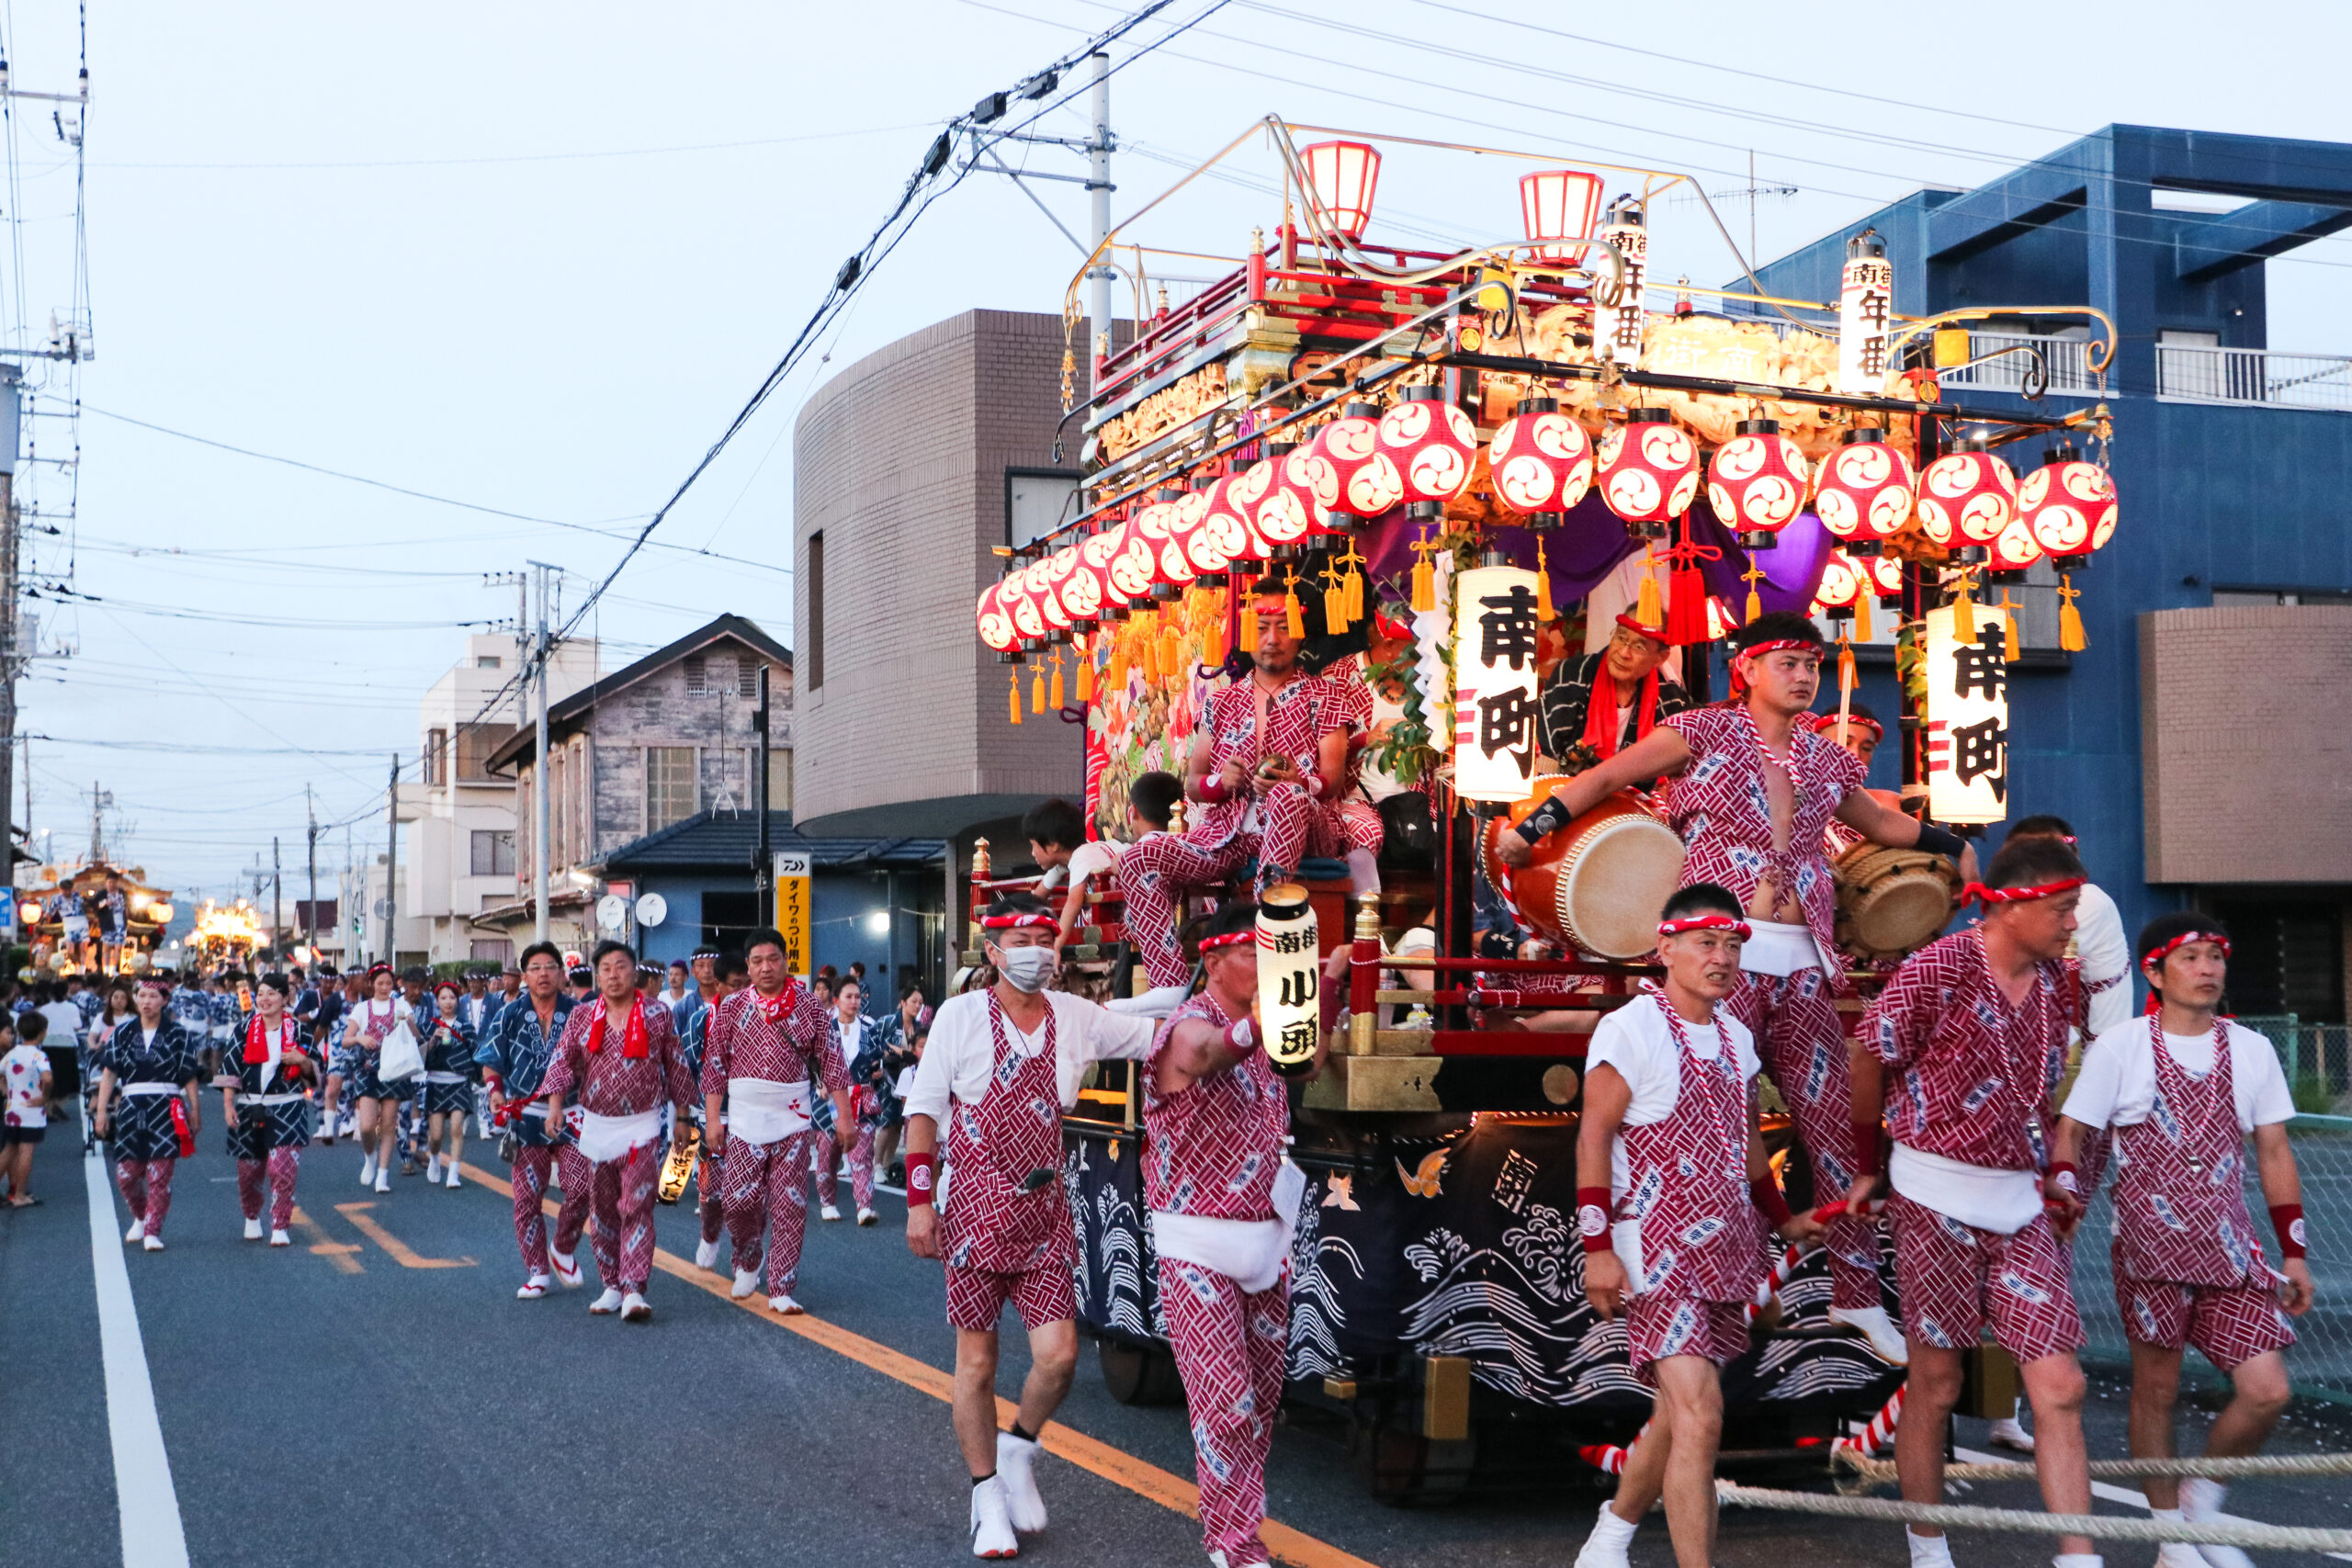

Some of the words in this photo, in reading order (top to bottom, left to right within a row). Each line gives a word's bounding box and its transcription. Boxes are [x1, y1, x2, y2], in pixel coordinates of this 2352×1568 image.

[1858, 289, 1888, 378] 年番
[1477, 585, 1539, 780] 南町
[1951, 622, 2008, 804] 南町
[788, 879, 799, 974] ダイワのつり用品
[1279, 967, 1317, 1055] 小頭
